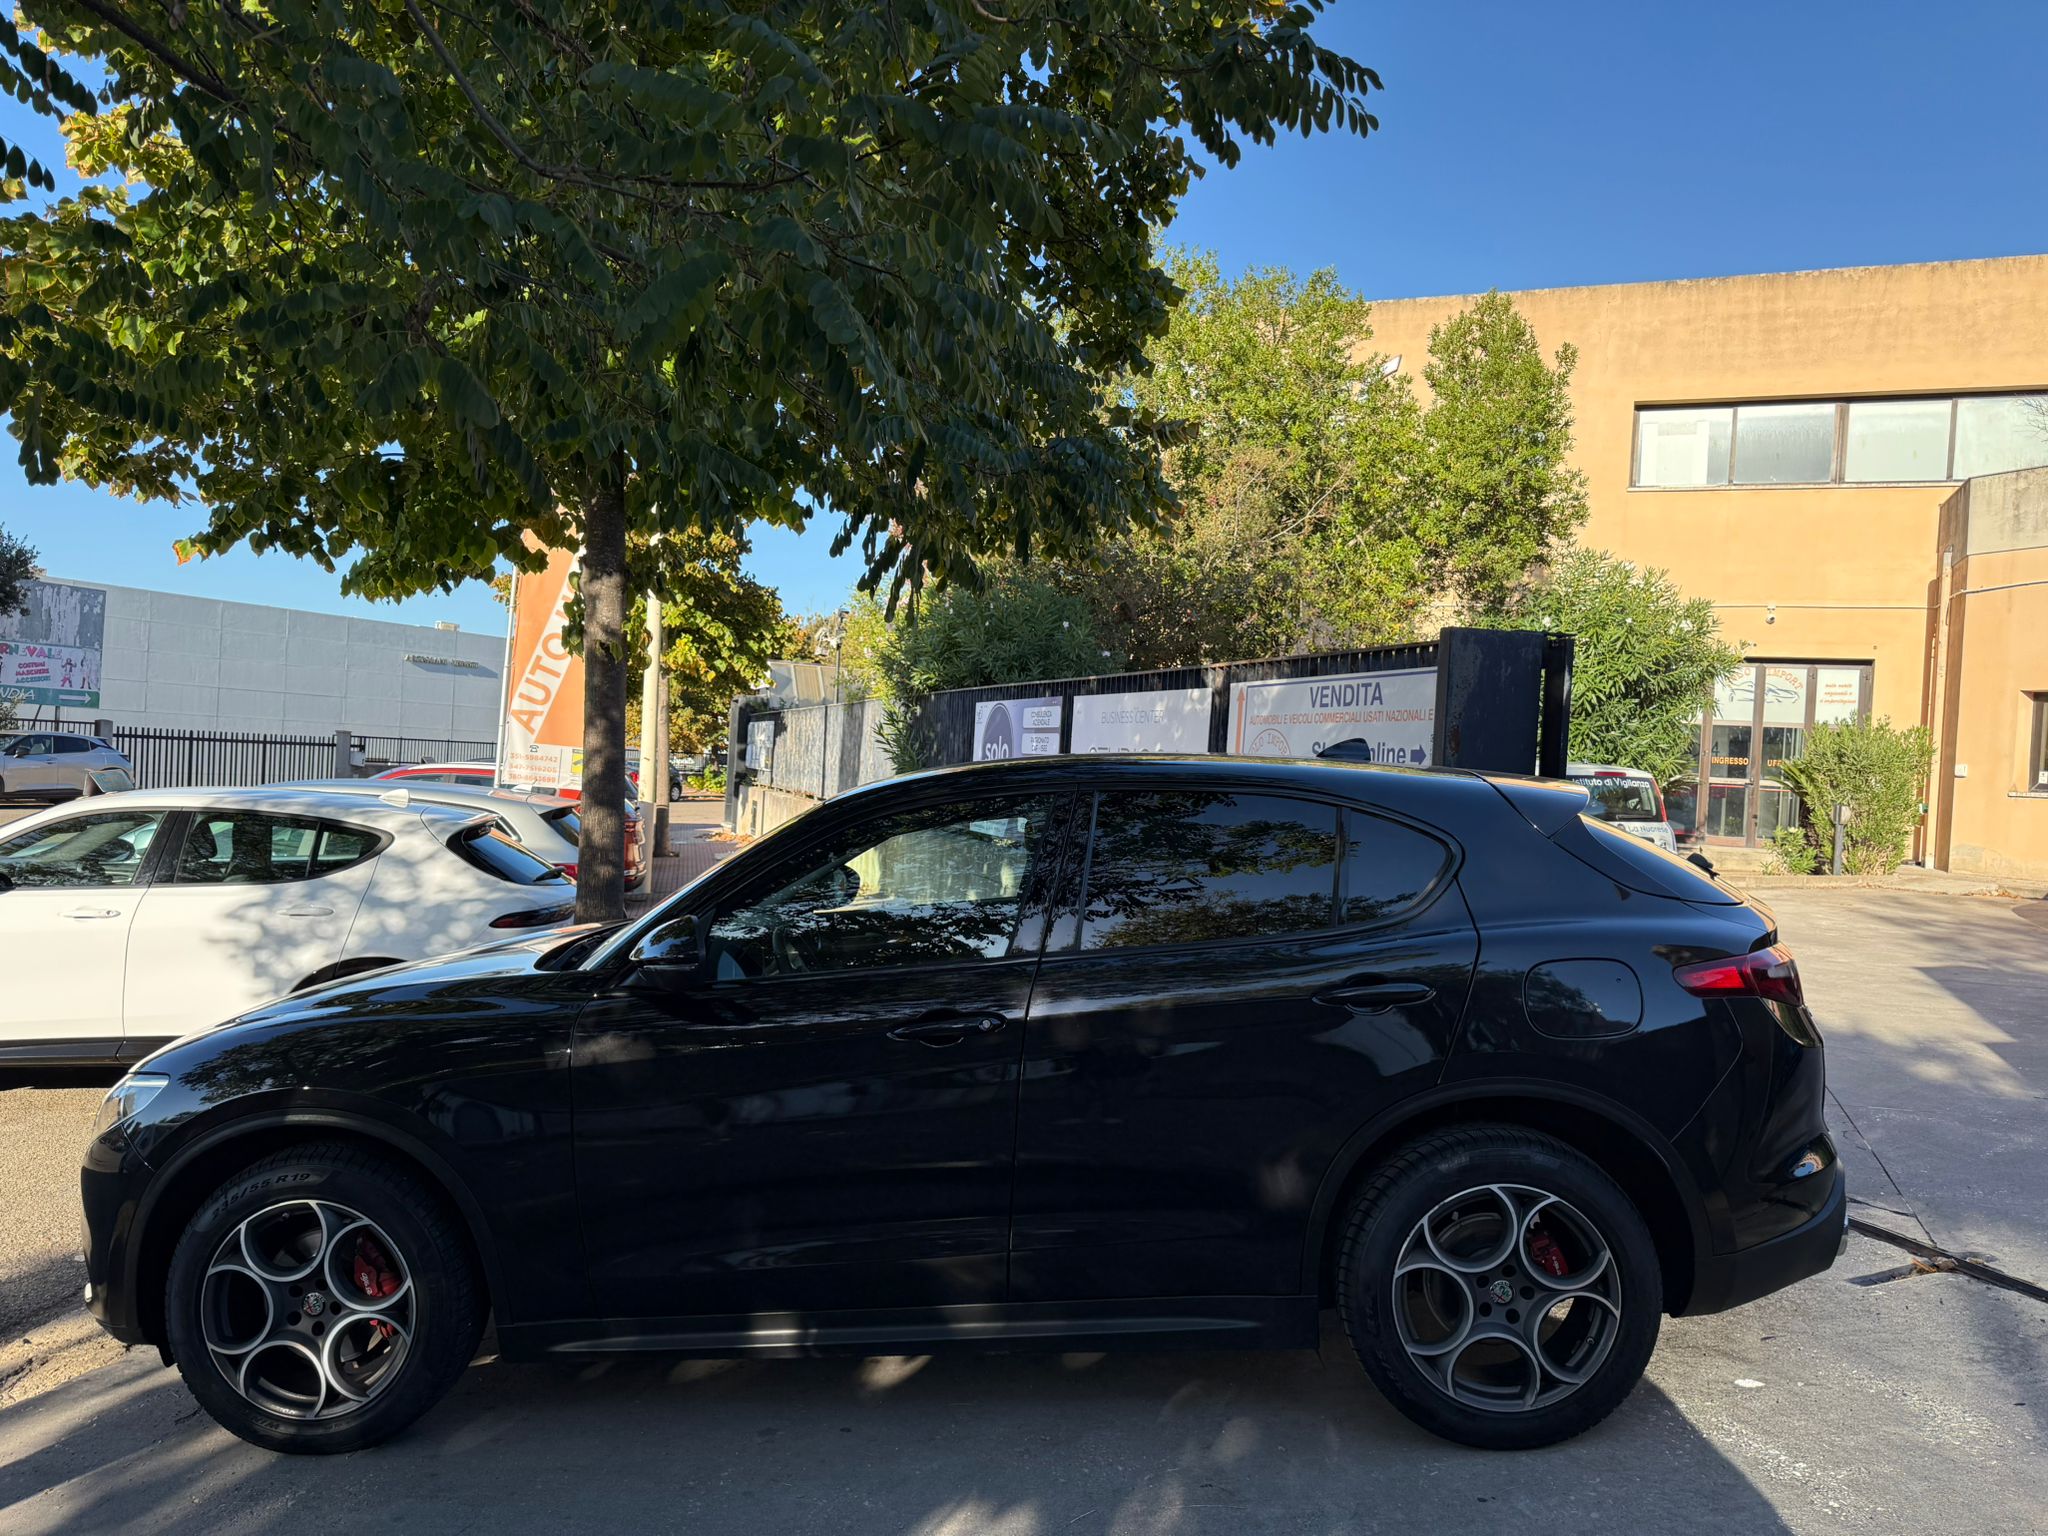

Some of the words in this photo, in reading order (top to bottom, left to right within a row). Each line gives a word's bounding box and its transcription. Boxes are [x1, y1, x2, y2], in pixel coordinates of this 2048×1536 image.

[1310, 682, 1383, 708] VENDITA
[1101, 711, 1133, 724] BUSINESS
[1135, 709, 1164, 723] CENTER
[1250, 713, 1282, 725] AUTOMOBILI
[1284, 713, 1289, 724] E
[1289, 712, 1313, 724] VEICOLI
[1314, 710, 1361, 723] COMMERCIALI
[1363, 710, 1384, 723] USATI
[1385, 709, 1427, 722] NAZIONALI
[1428, 709, 1434, 721] E
[985, 735, 1009, 760] solo
[1371, 741, 1406, 764] nline
[1711, 756, 1749, 766] INGRESSO
[1767, 759, 1784, 767] UFF
[1605, 777, 1613, 786] di
[1613, 777, 1650, 788] Vigilanza
[275, 1173, 311, 1184] R19
